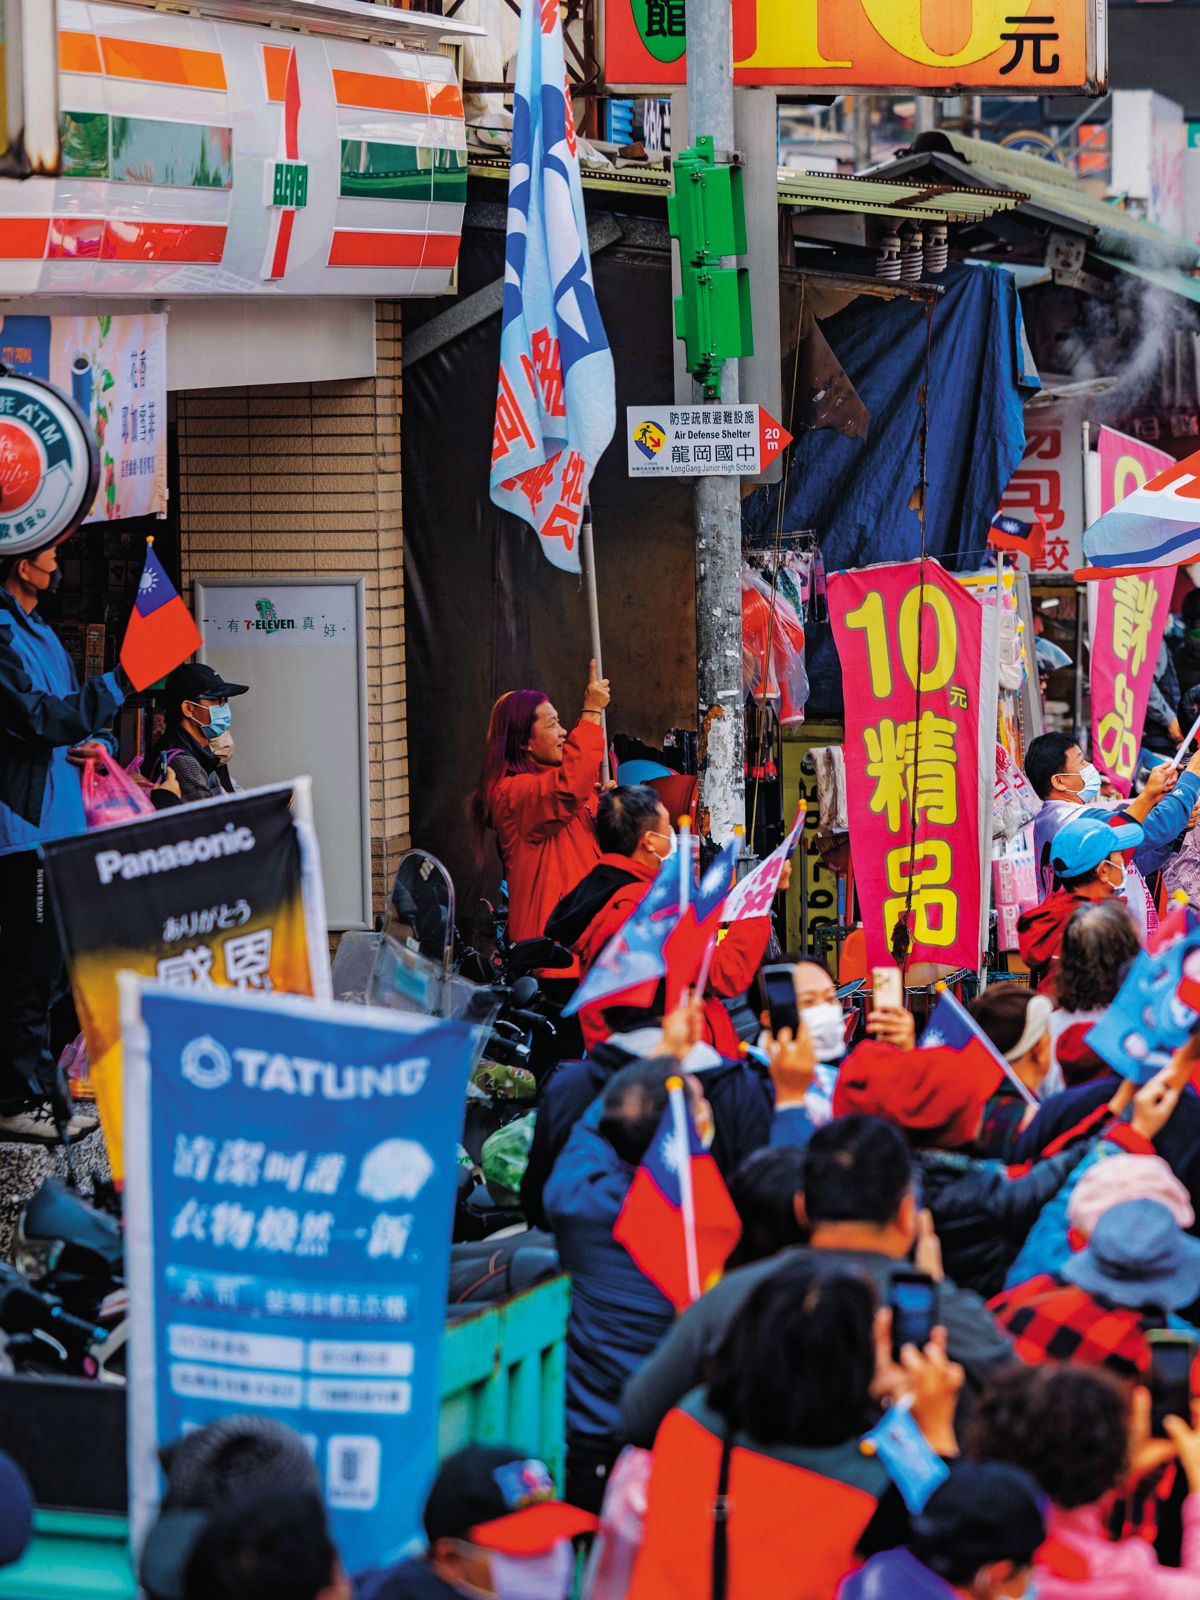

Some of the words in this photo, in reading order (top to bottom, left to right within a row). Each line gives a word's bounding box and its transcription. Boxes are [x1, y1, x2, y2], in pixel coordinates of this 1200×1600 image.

[999, 16, 1060, 75] 元
[16, 402, 63, 446] ATM
[670, 410, 755, 426] 防空疏散避難設施
[674, 430, 686, 440] Air
[688, 429, 720, 440] Defense
[722, 429, 751, 439] Shelter
[765, 428, 780, 439] 20
[671, 444, 755, 463] 龍岡國中
[767, 441, 779, 450] m
[671, 465, 701, 474] LongGang
[702, 465, 720, 473] Junior
[721, 464, 734, 474] High
[736, 463, 756, 472] School
[227, 619, 239, 633] 有
[844, 583, 959, 699] 10
[948, 684, 969, 709] 元
[861, 708, 959, 950] 精品
[95, 822, 256, 884] Panasonic
[162, 898, 252, 943] ありがとう
[157, 927, 273, 993] 感恩
[232, 1047, 431, 1101] TATUNG
